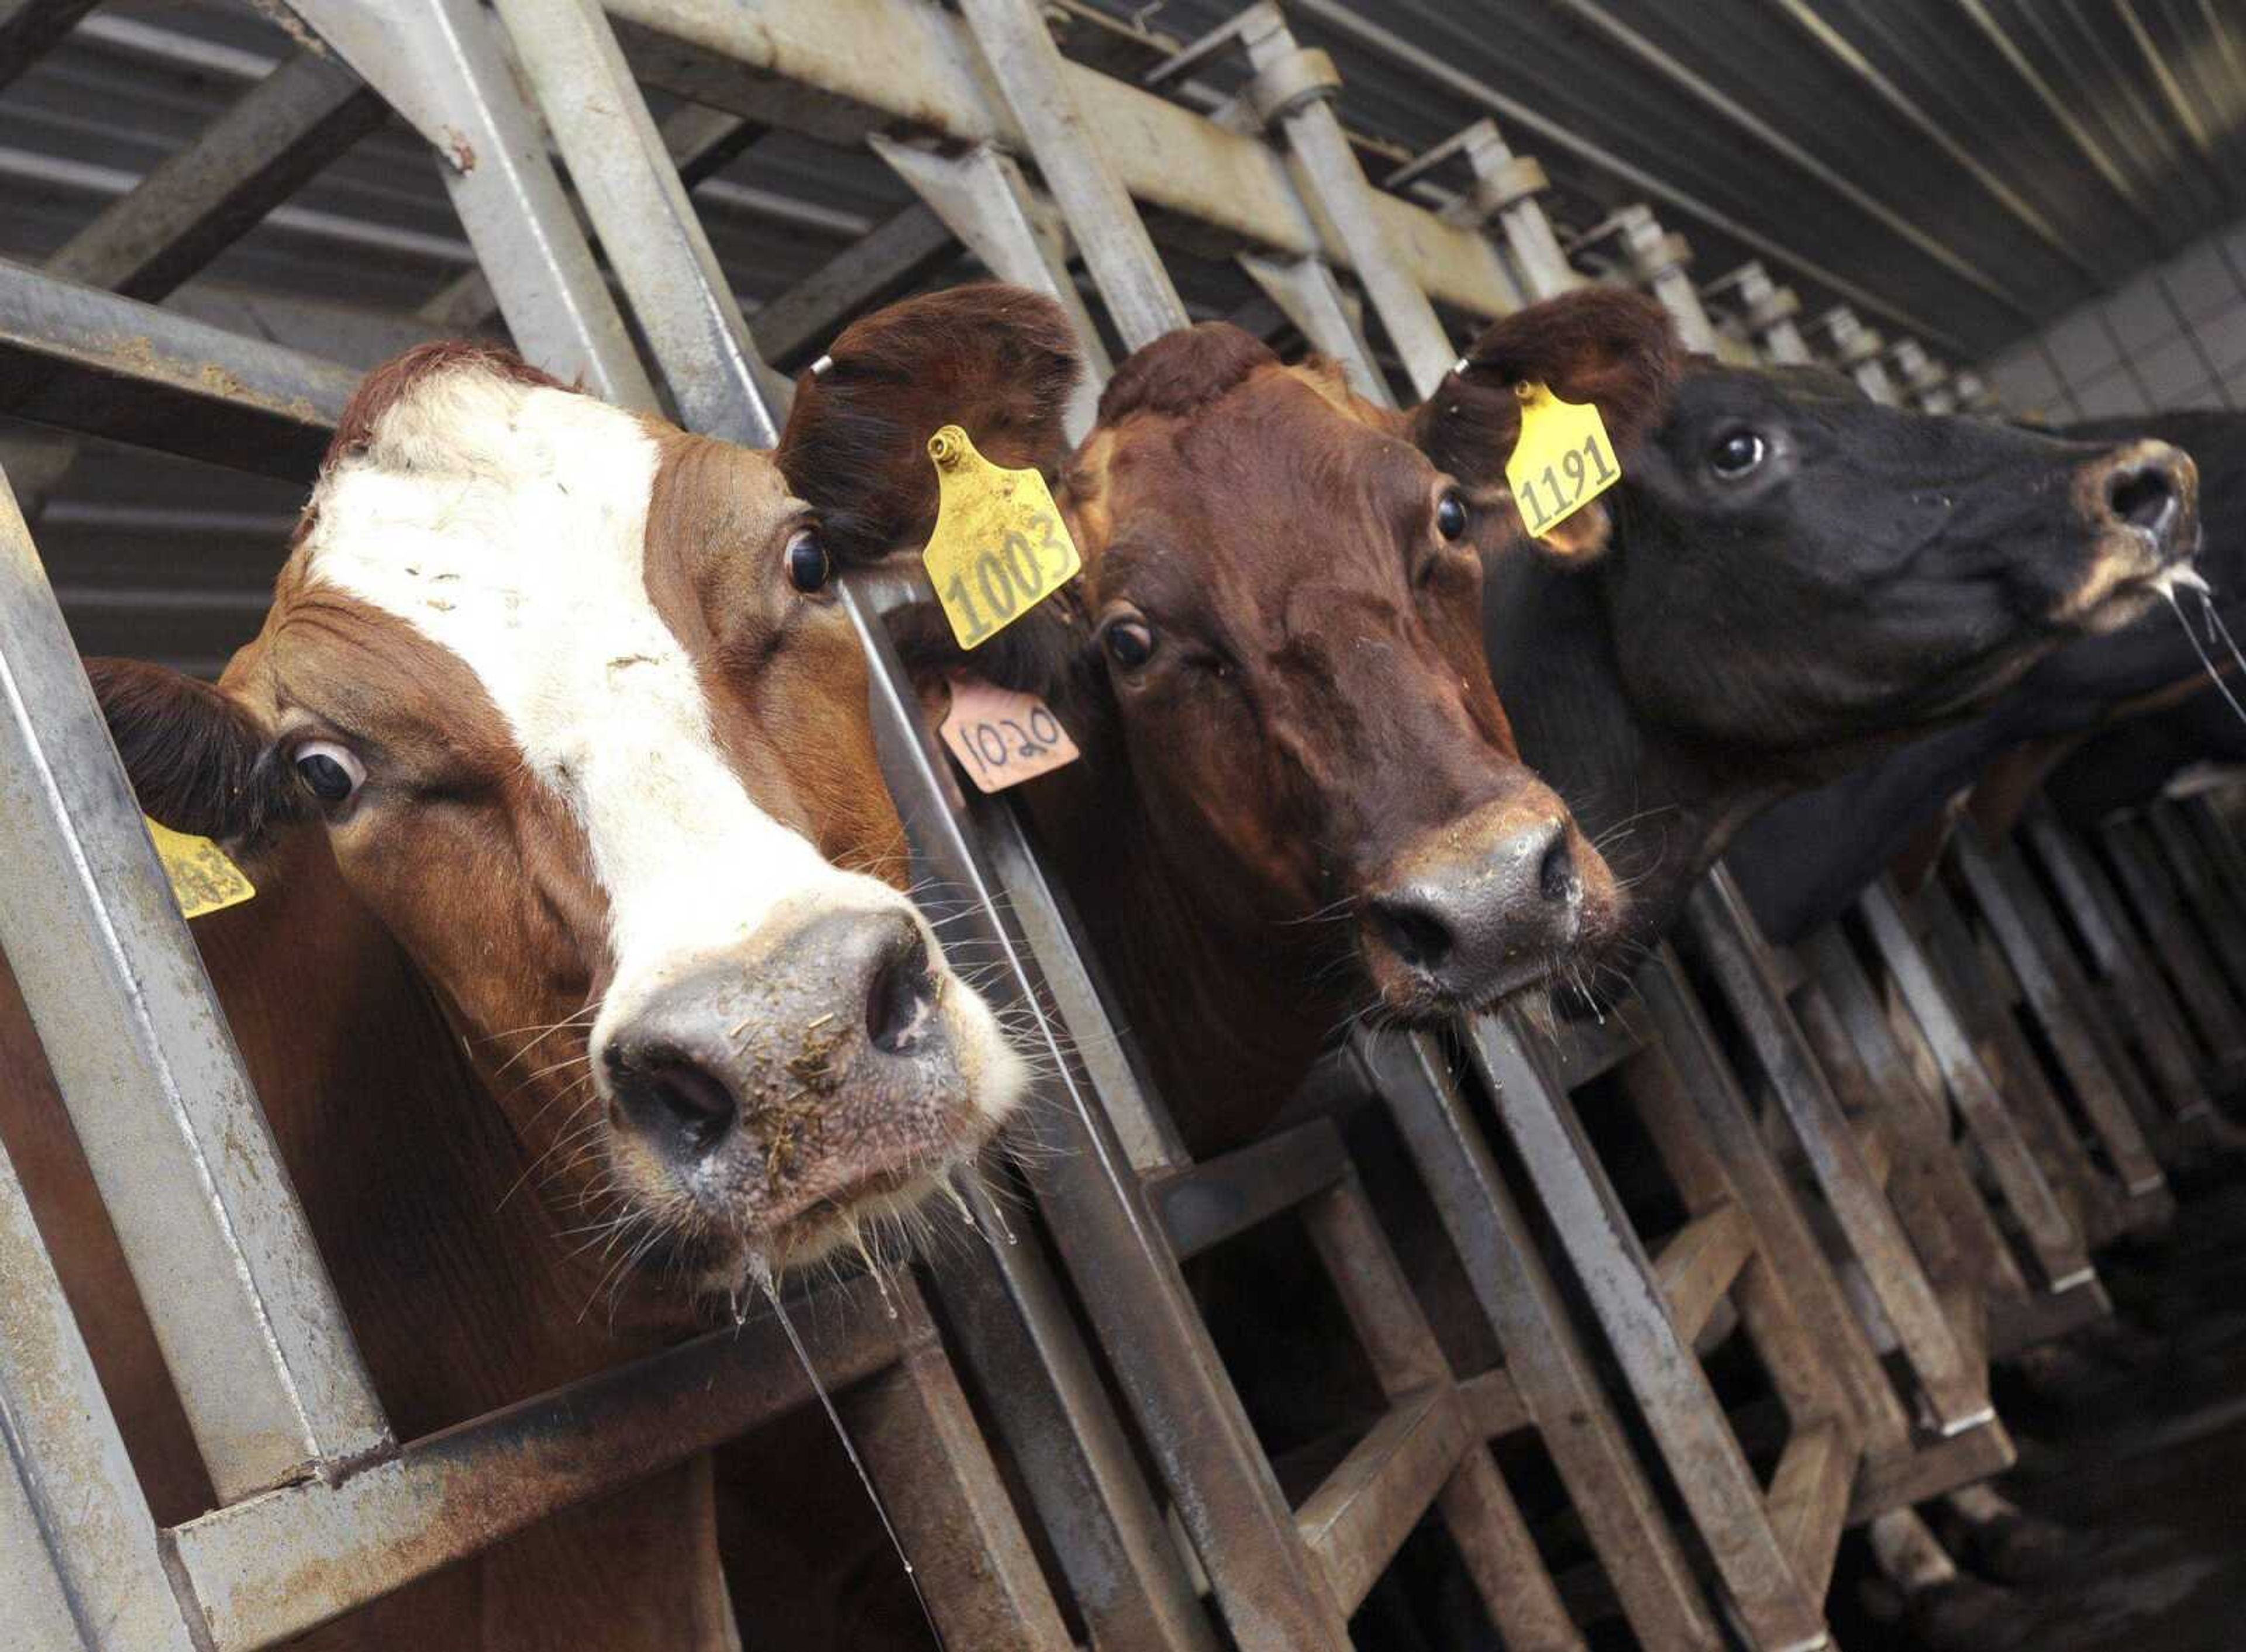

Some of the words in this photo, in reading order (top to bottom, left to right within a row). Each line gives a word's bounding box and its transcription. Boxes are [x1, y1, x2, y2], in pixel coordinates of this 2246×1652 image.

[1521, 434, 1615, 530] 1191
[946, 508, 1070, 644] 1003
[960, 705, 1058, 773] 1020
